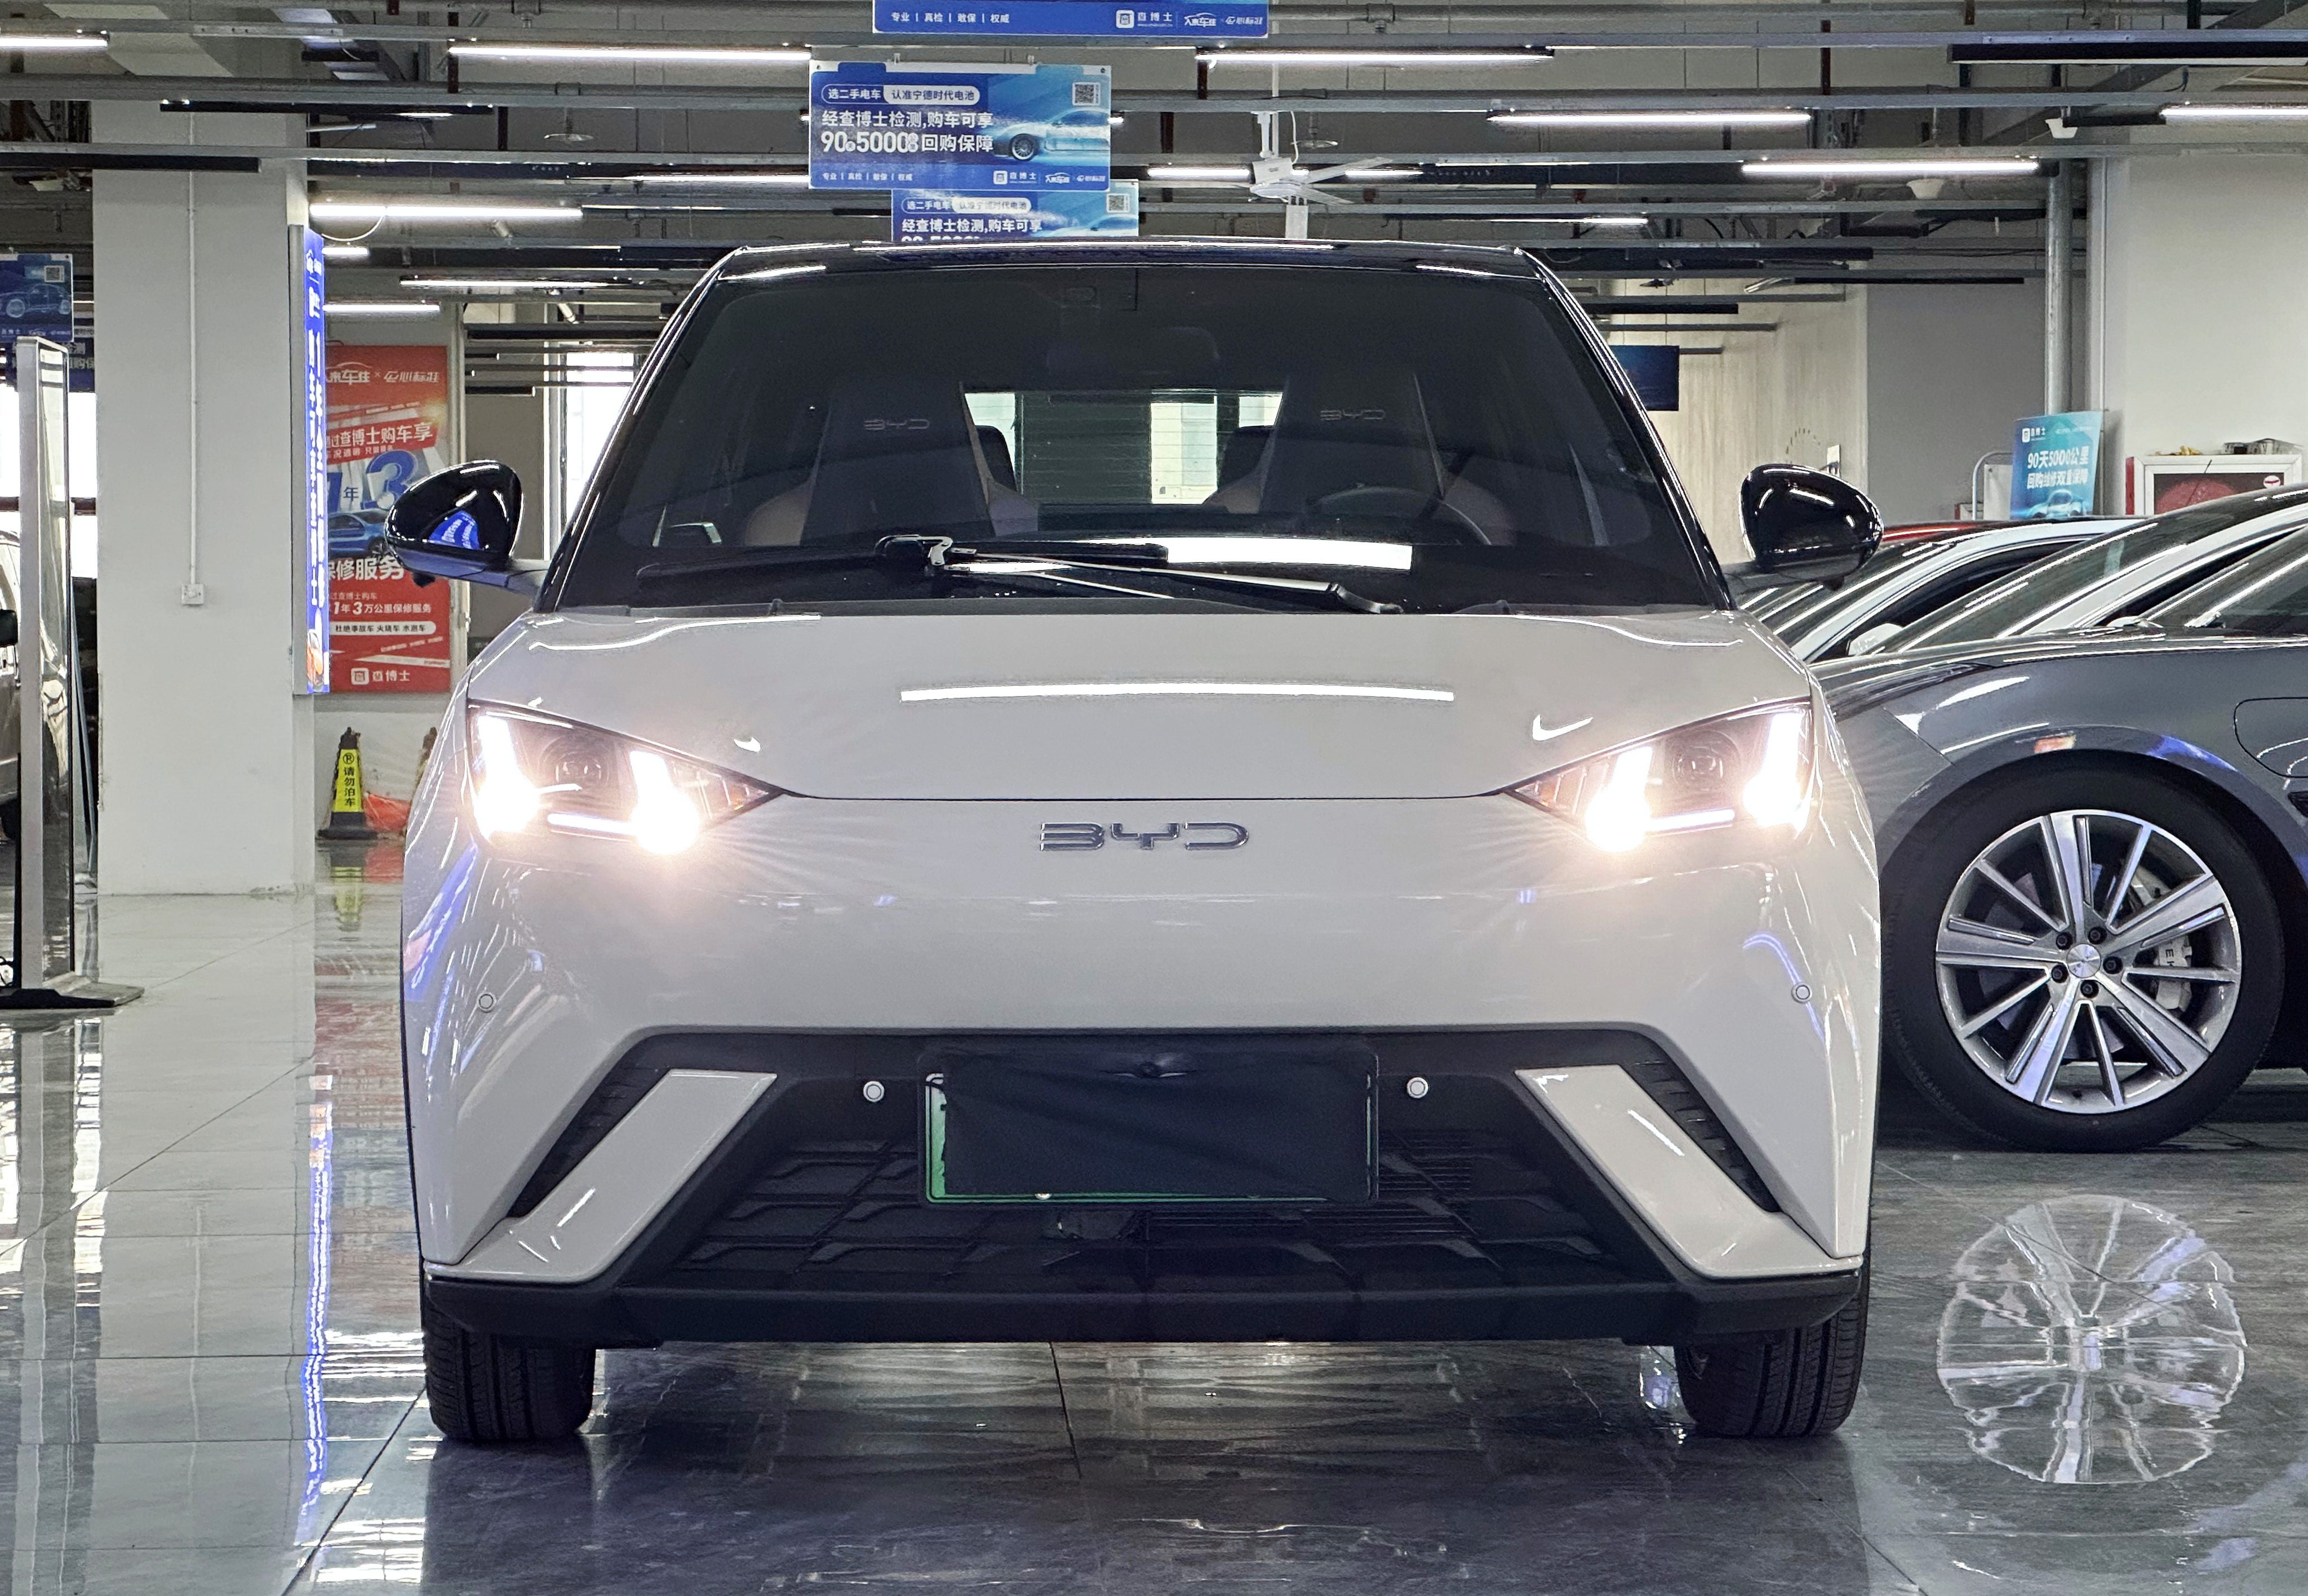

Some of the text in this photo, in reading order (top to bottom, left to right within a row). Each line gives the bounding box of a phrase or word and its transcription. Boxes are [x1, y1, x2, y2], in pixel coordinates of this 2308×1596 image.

[891, 12, 1010, 24] 专业 真检 敢保 权威
[1137, 12, 1172, 22] 查博士
[828, 88, 975, 101] 选二手电车 认准宁德时代电池
[822, 110, 993, 128] 经查博士检测,购车可享
[902, 219, 1042, 234] 经查博士检测,购车可享
[1320, 409, 1386, 421] BYD
[863, 419, 930, 430] BYD
[2027, 446, 2089, 469] 90天5000公里
[372, 670, 410, 682] 查博士
[344, 767, 356, 807] 请勿泊车
[1040, 823, 1249, 850] BYD
